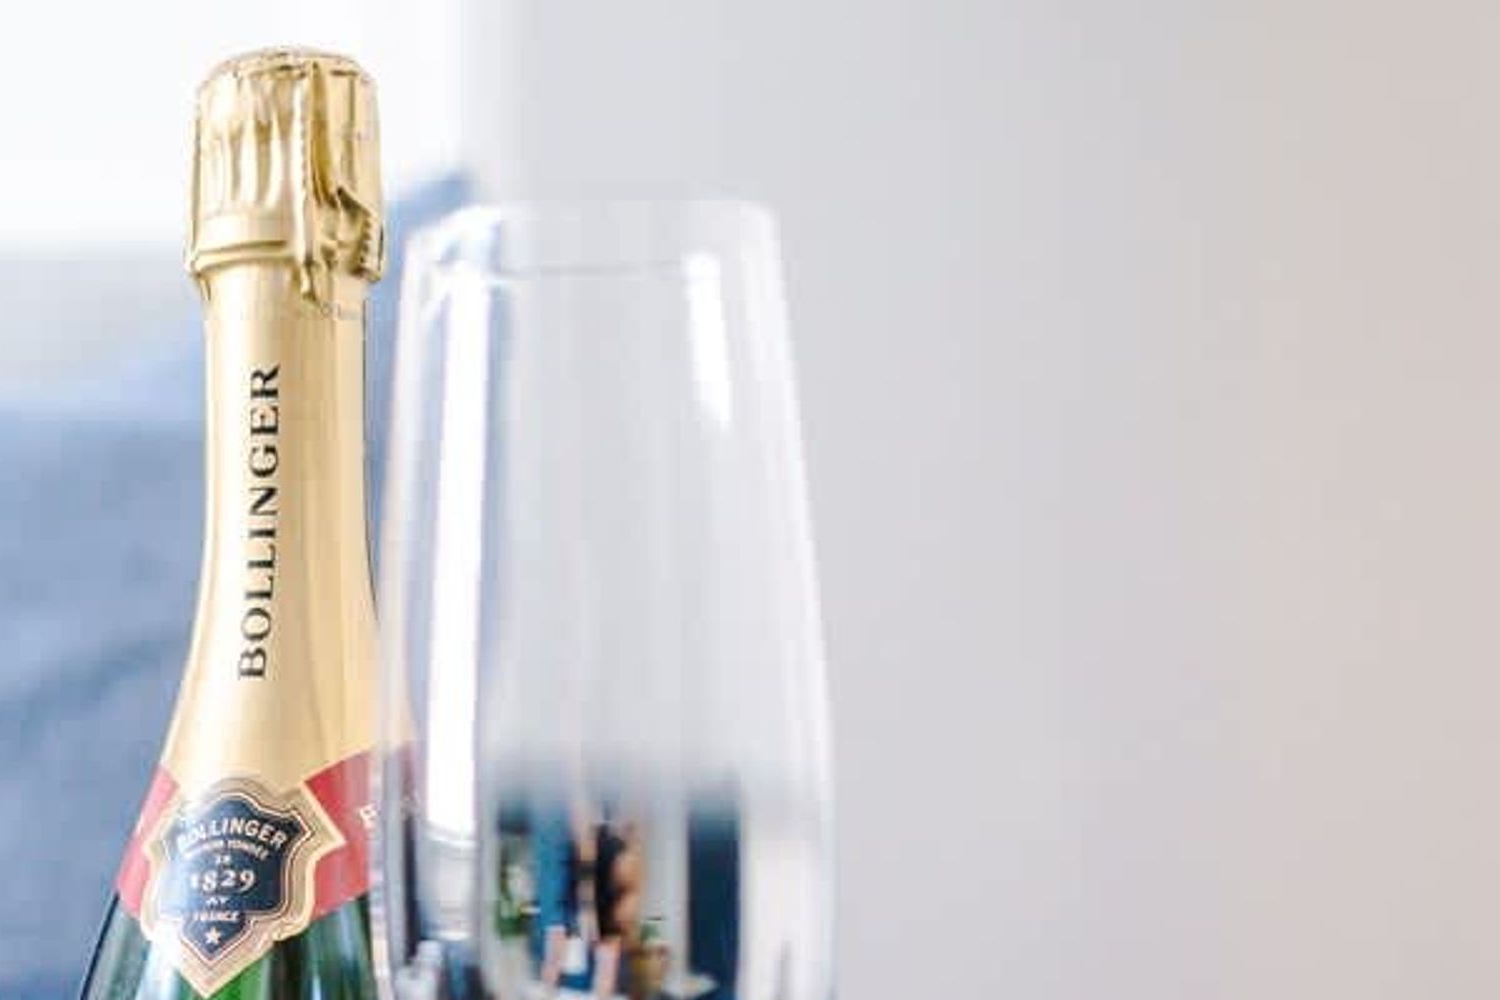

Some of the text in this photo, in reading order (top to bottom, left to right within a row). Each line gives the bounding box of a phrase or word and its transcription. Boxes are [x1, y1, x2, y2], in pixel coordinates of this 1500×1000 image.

[238, 363, 281, 680] BOLLINGER
[177, 817, 287, 854] BOLLINGER
[189, 870, 255, 893] 1829
